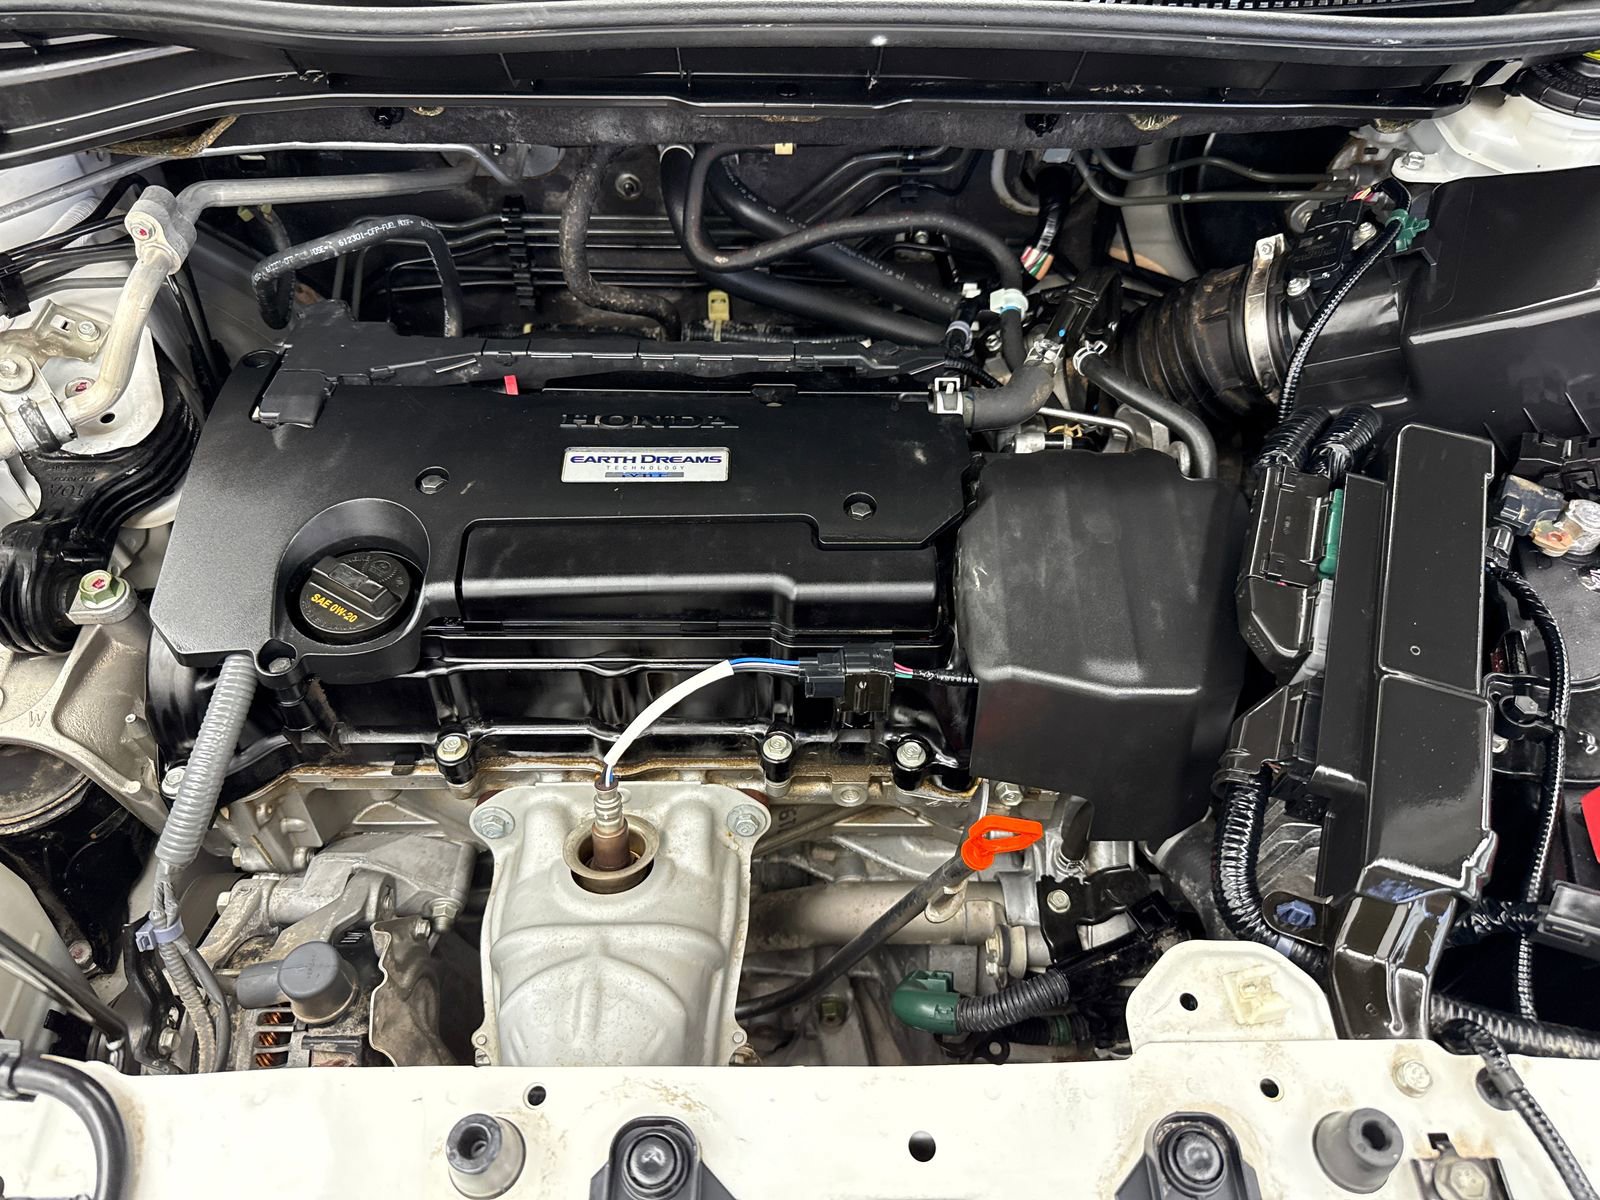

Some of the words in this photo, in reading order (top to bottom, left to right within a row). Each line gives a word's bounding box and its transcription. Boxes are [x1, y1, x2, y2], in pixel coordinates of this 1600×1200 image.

[560, 413, 739, 429] HONDA
[570, 454, 637, 464] EARTH
[640, 453, 723, 464] DREAMS
[311, 593, 333, 609] SAE
[329, 603, 359, 623] 0W-20
